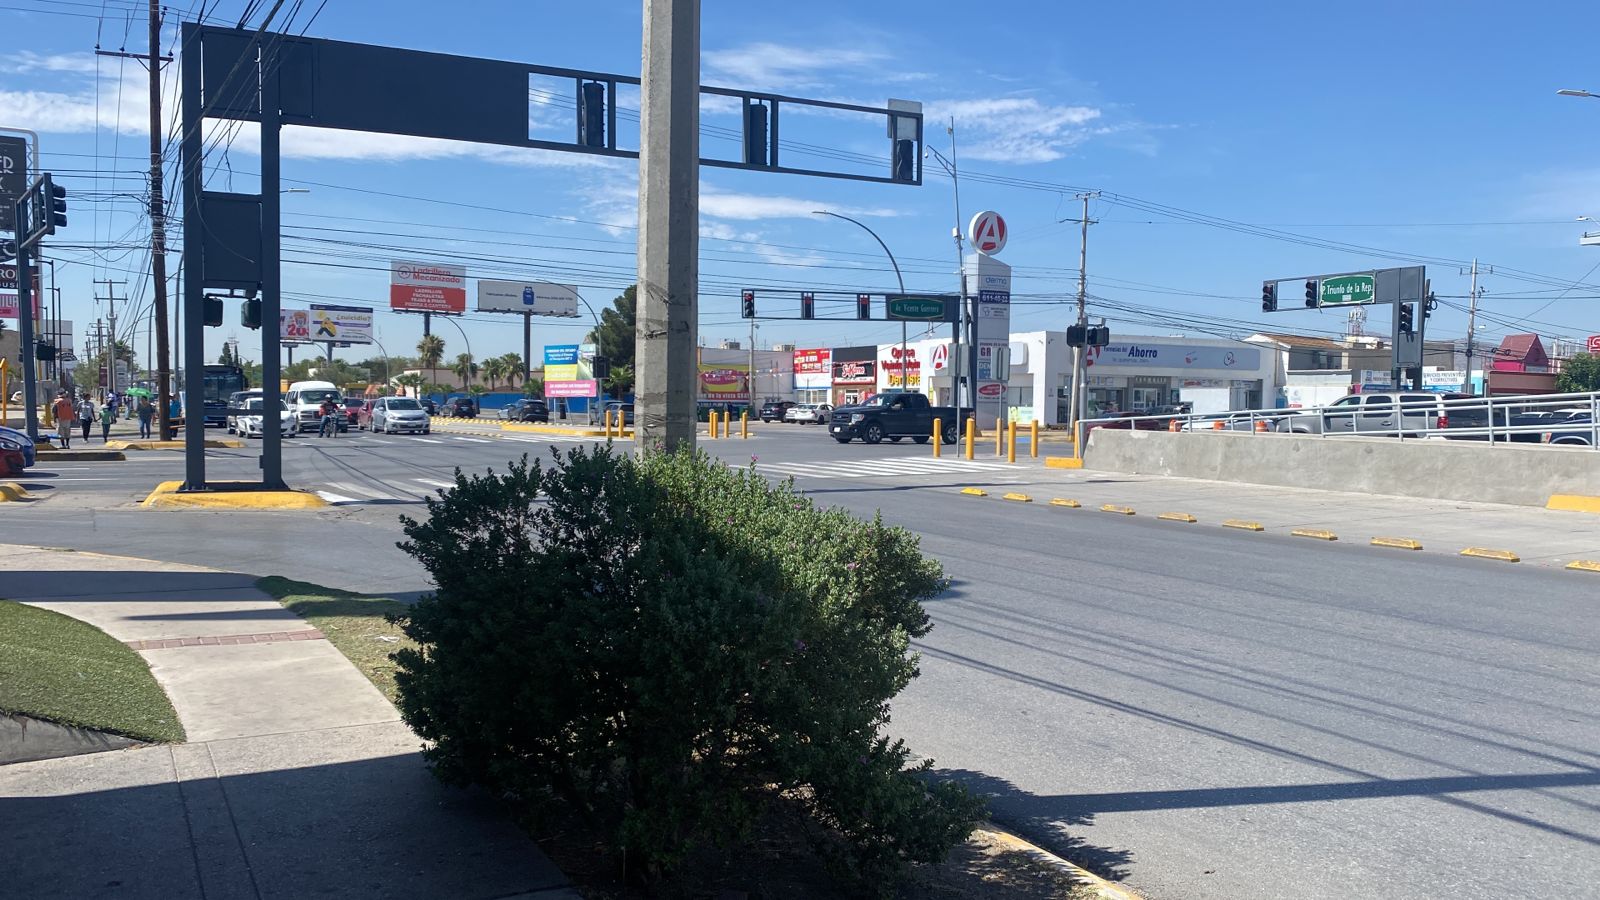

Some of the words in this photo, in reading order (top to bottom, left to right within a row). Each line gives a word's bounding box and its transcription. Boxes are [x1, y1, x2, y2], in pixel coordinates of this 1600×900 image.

[1327, 283, 1345, 295] Triunfo
[1346, 282, 1353, 294] de
[1354, 282, 1360, 293] la
[1361, 281, 1373, 295] Rep.
[1128, 345, 1158, 359] Ahorro
